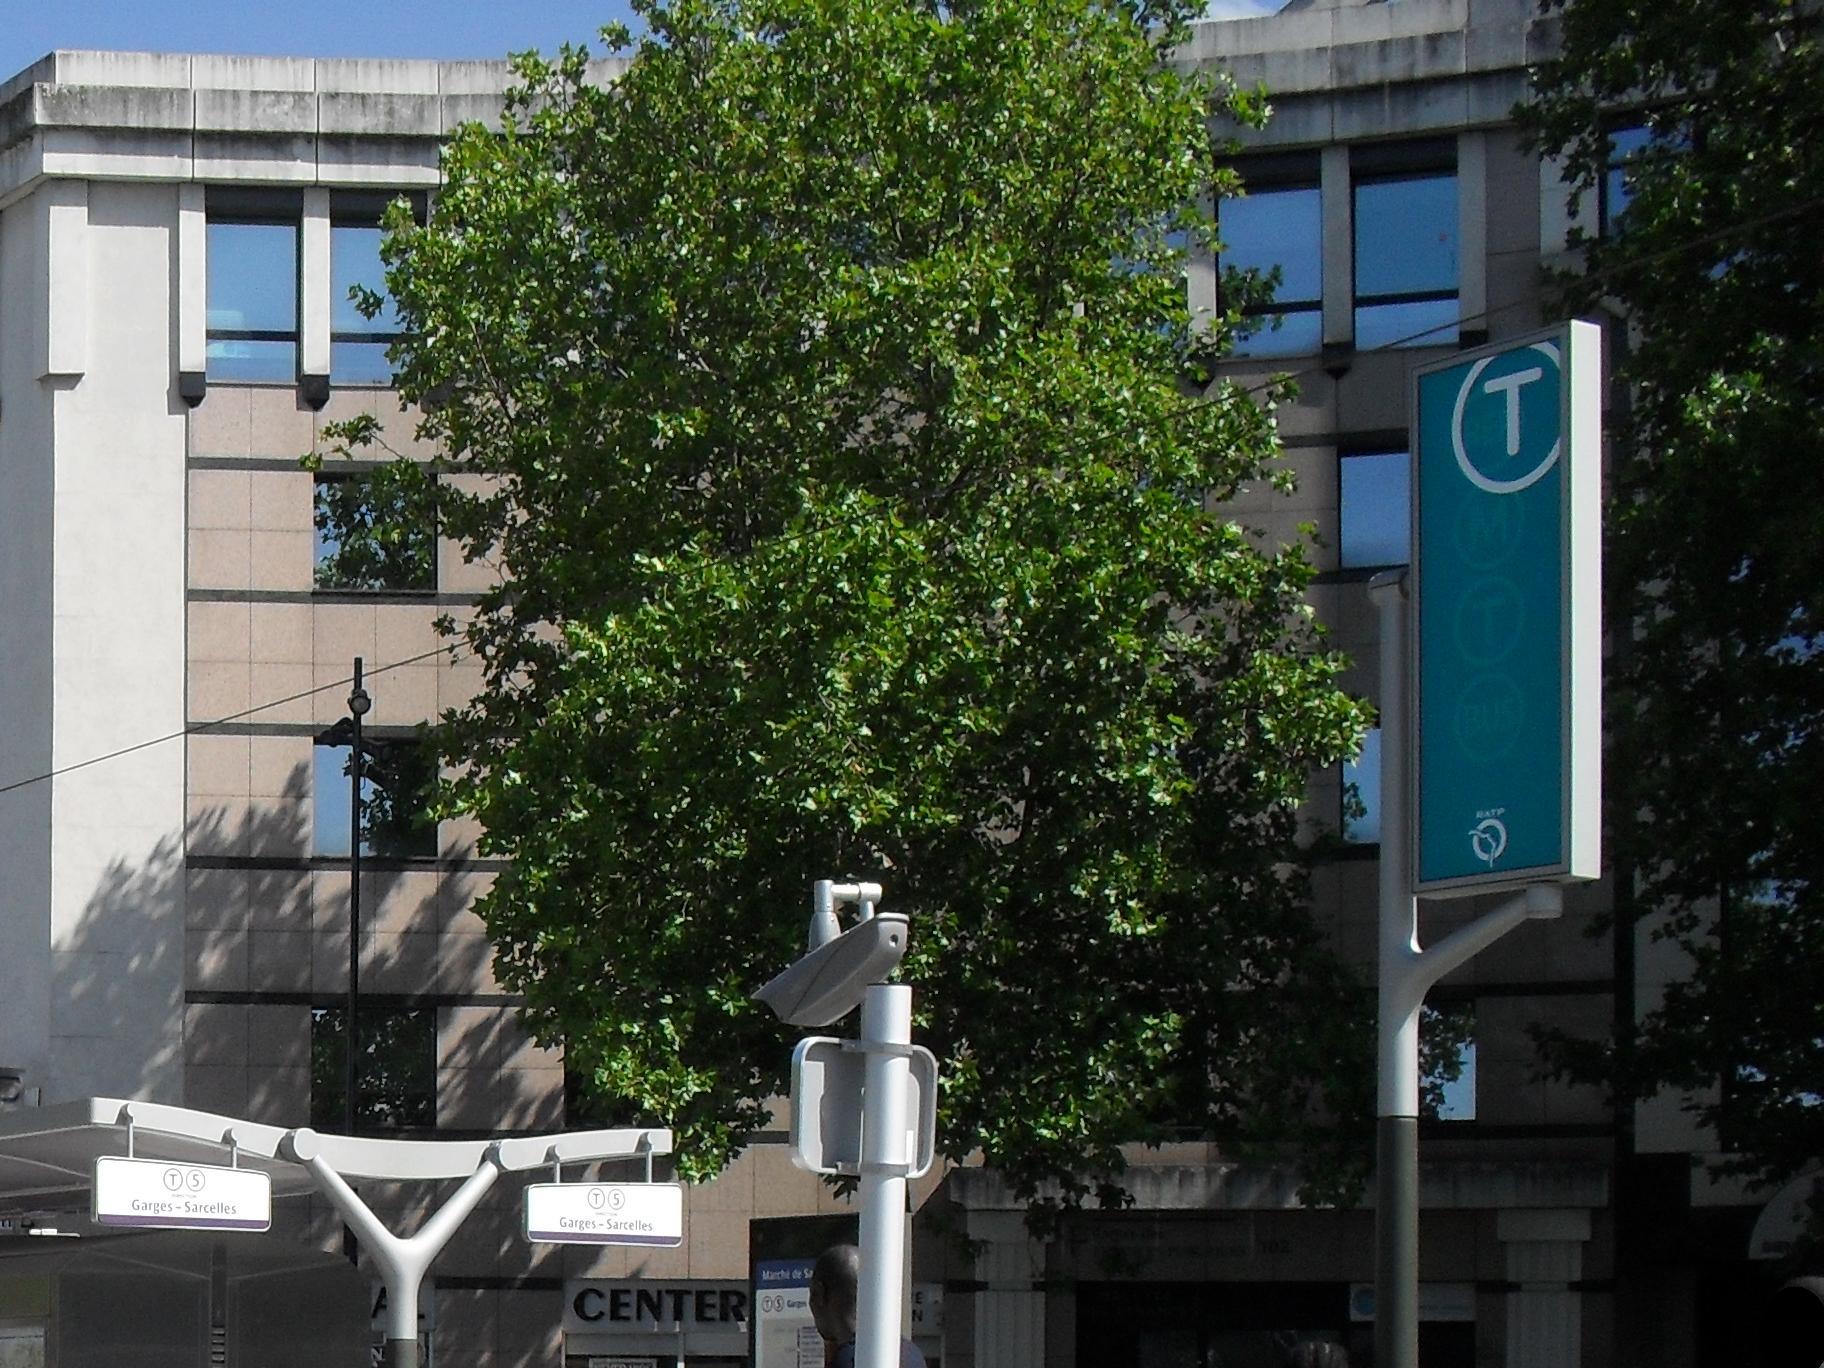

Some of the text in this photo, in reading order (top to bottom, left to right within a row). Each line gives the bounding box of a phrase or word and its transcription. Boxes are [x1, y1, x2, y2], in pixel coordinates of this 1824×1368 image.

[1484, 367, 1543, 457] T
[131, 1199, 173, 1214] Garges
[184, 1201, 237, 1214] Sarcelles
[559, 1217, 596, 1231] Garges
[606, 1218, 653, 1232] Sarcelles
[762, 1268, 790, 1280] Marché
[792, 1269, 802, 1280] de
[573, 1288, 747, 1322] CENTER
